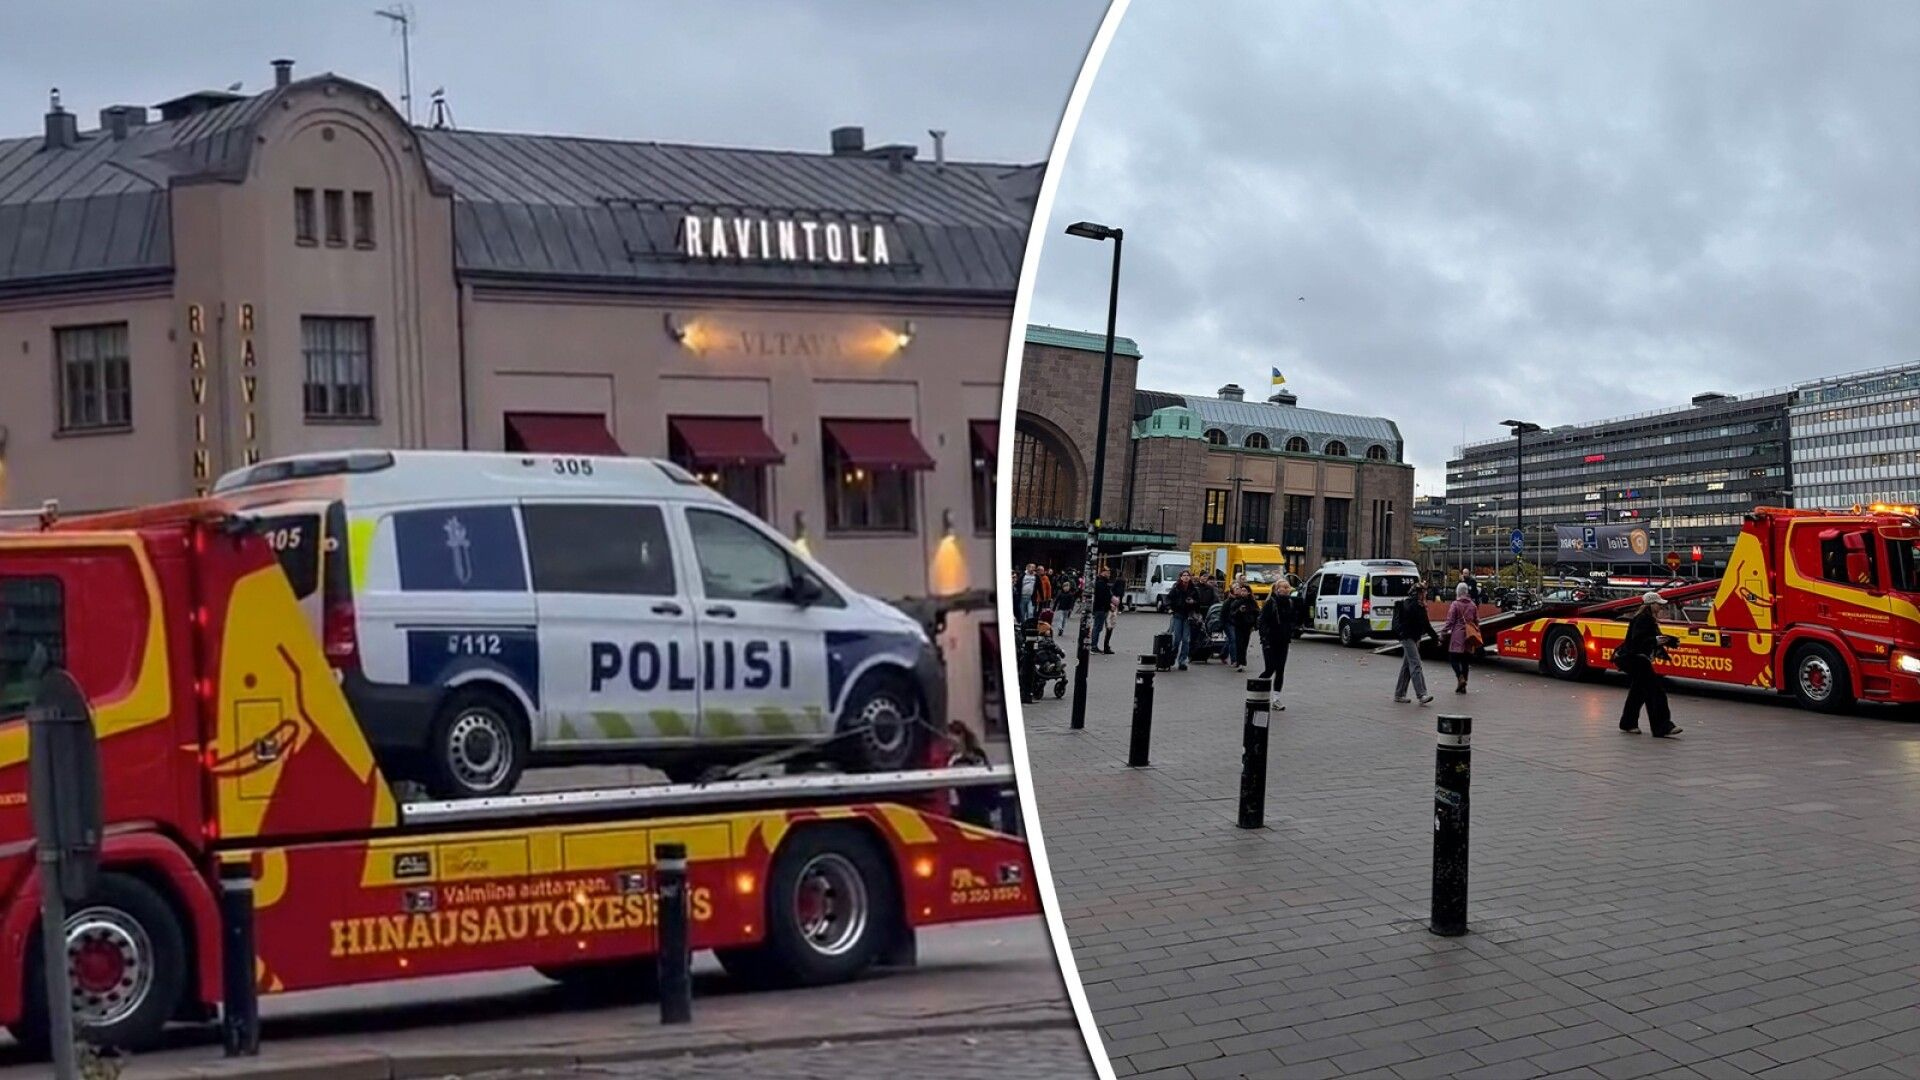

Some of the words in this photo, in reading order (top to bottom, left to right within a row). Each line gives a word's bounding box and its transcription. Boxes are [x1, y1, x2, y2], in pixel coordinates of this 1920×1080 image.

[685, 215, 889, 265] RAVINTOLA
[552, 458, 593, 476] 305
[1585, 528, 1594, 542] P
[1693, 546, 1701, 555] M
[463, 635, 501, 655] 112
[1875, 644, 1885, 654] 16
[590, 640, 791, 692] POLIISI
[444, 884, 516, 905] Valmiina
